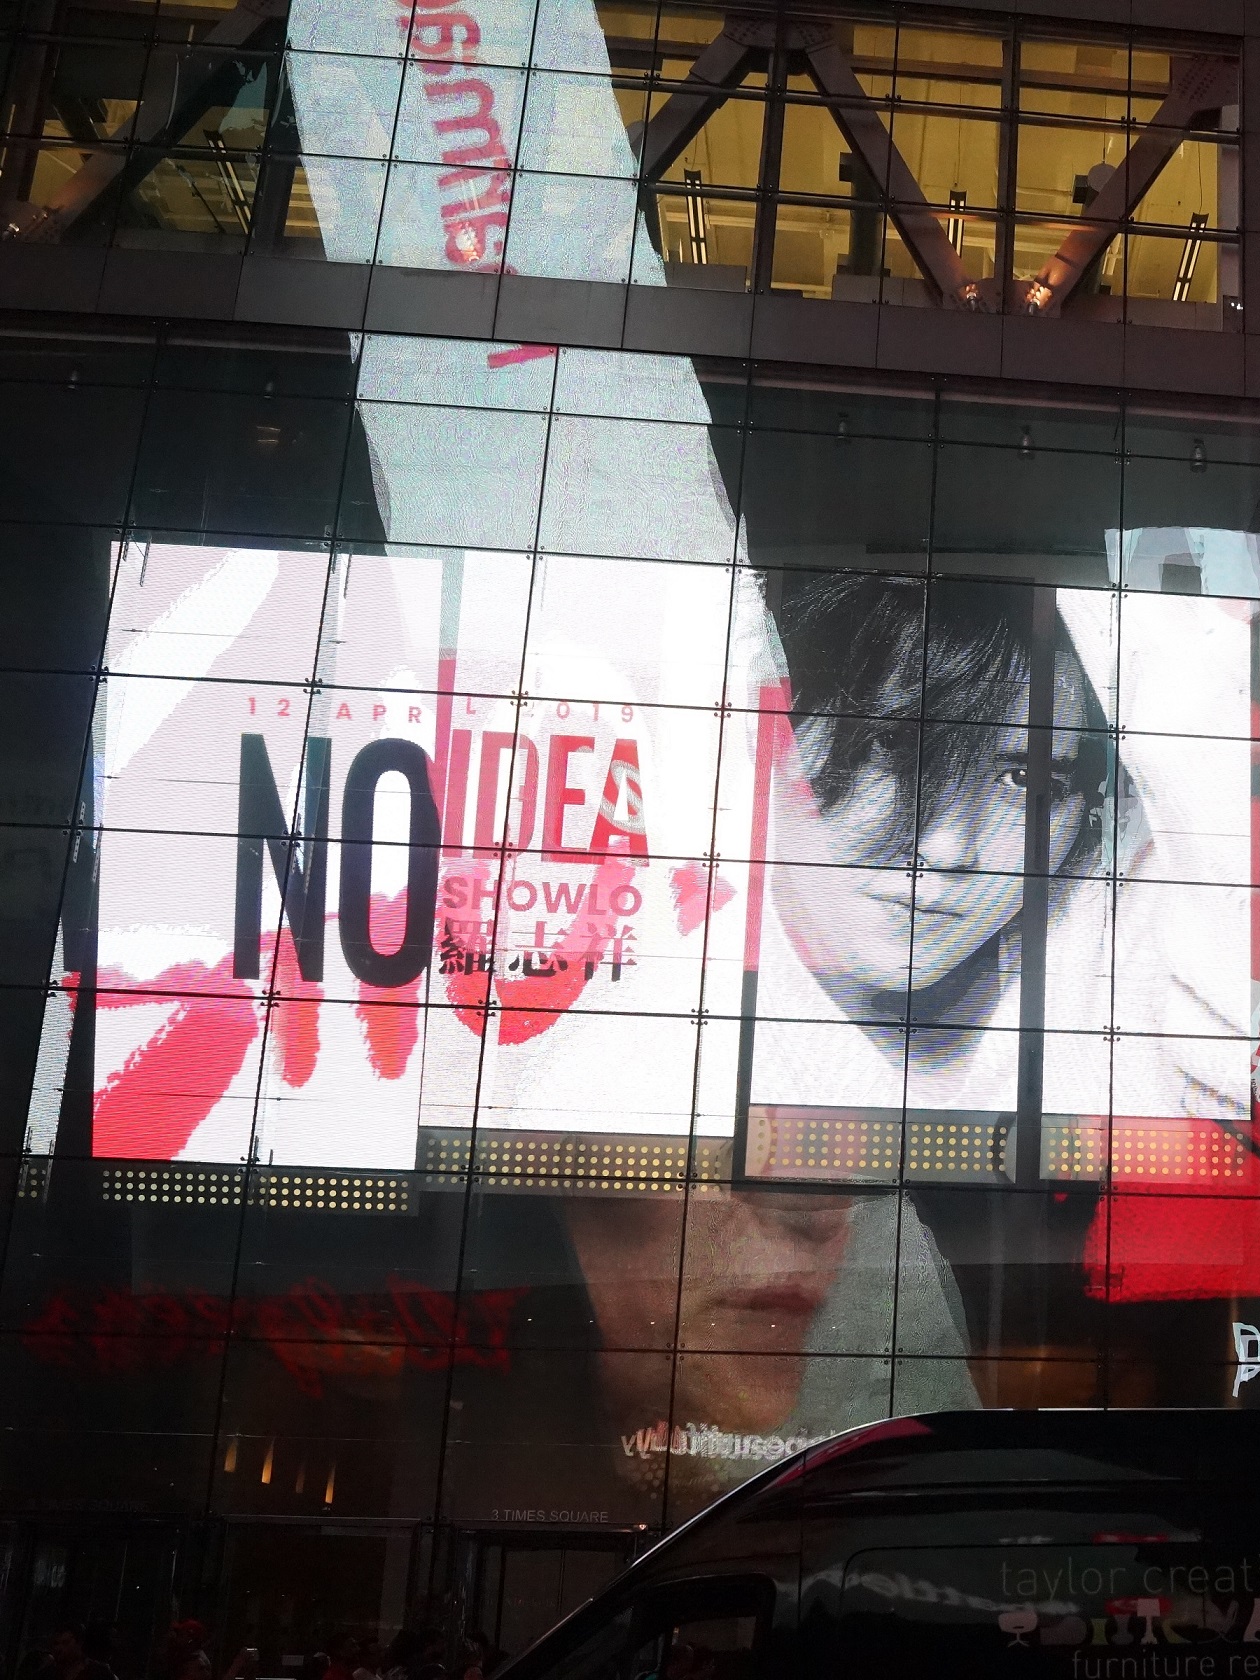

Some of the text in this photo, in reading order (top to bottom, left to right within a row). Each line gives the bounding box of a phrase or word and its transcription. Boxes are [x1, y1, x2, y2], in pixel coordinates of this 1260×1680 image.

[247, 695, 634, 725] 12 APRL 019
[232, 729, 650, 988] NO IDEA
[442, 875, 643, 917] SHOWLO
[490, 1508, 609, 1523] 3 TIMES SQUARE
[1000, 1557, 1127, 1600] taylor
[1071, 1648, 1216, 1680] furniture
